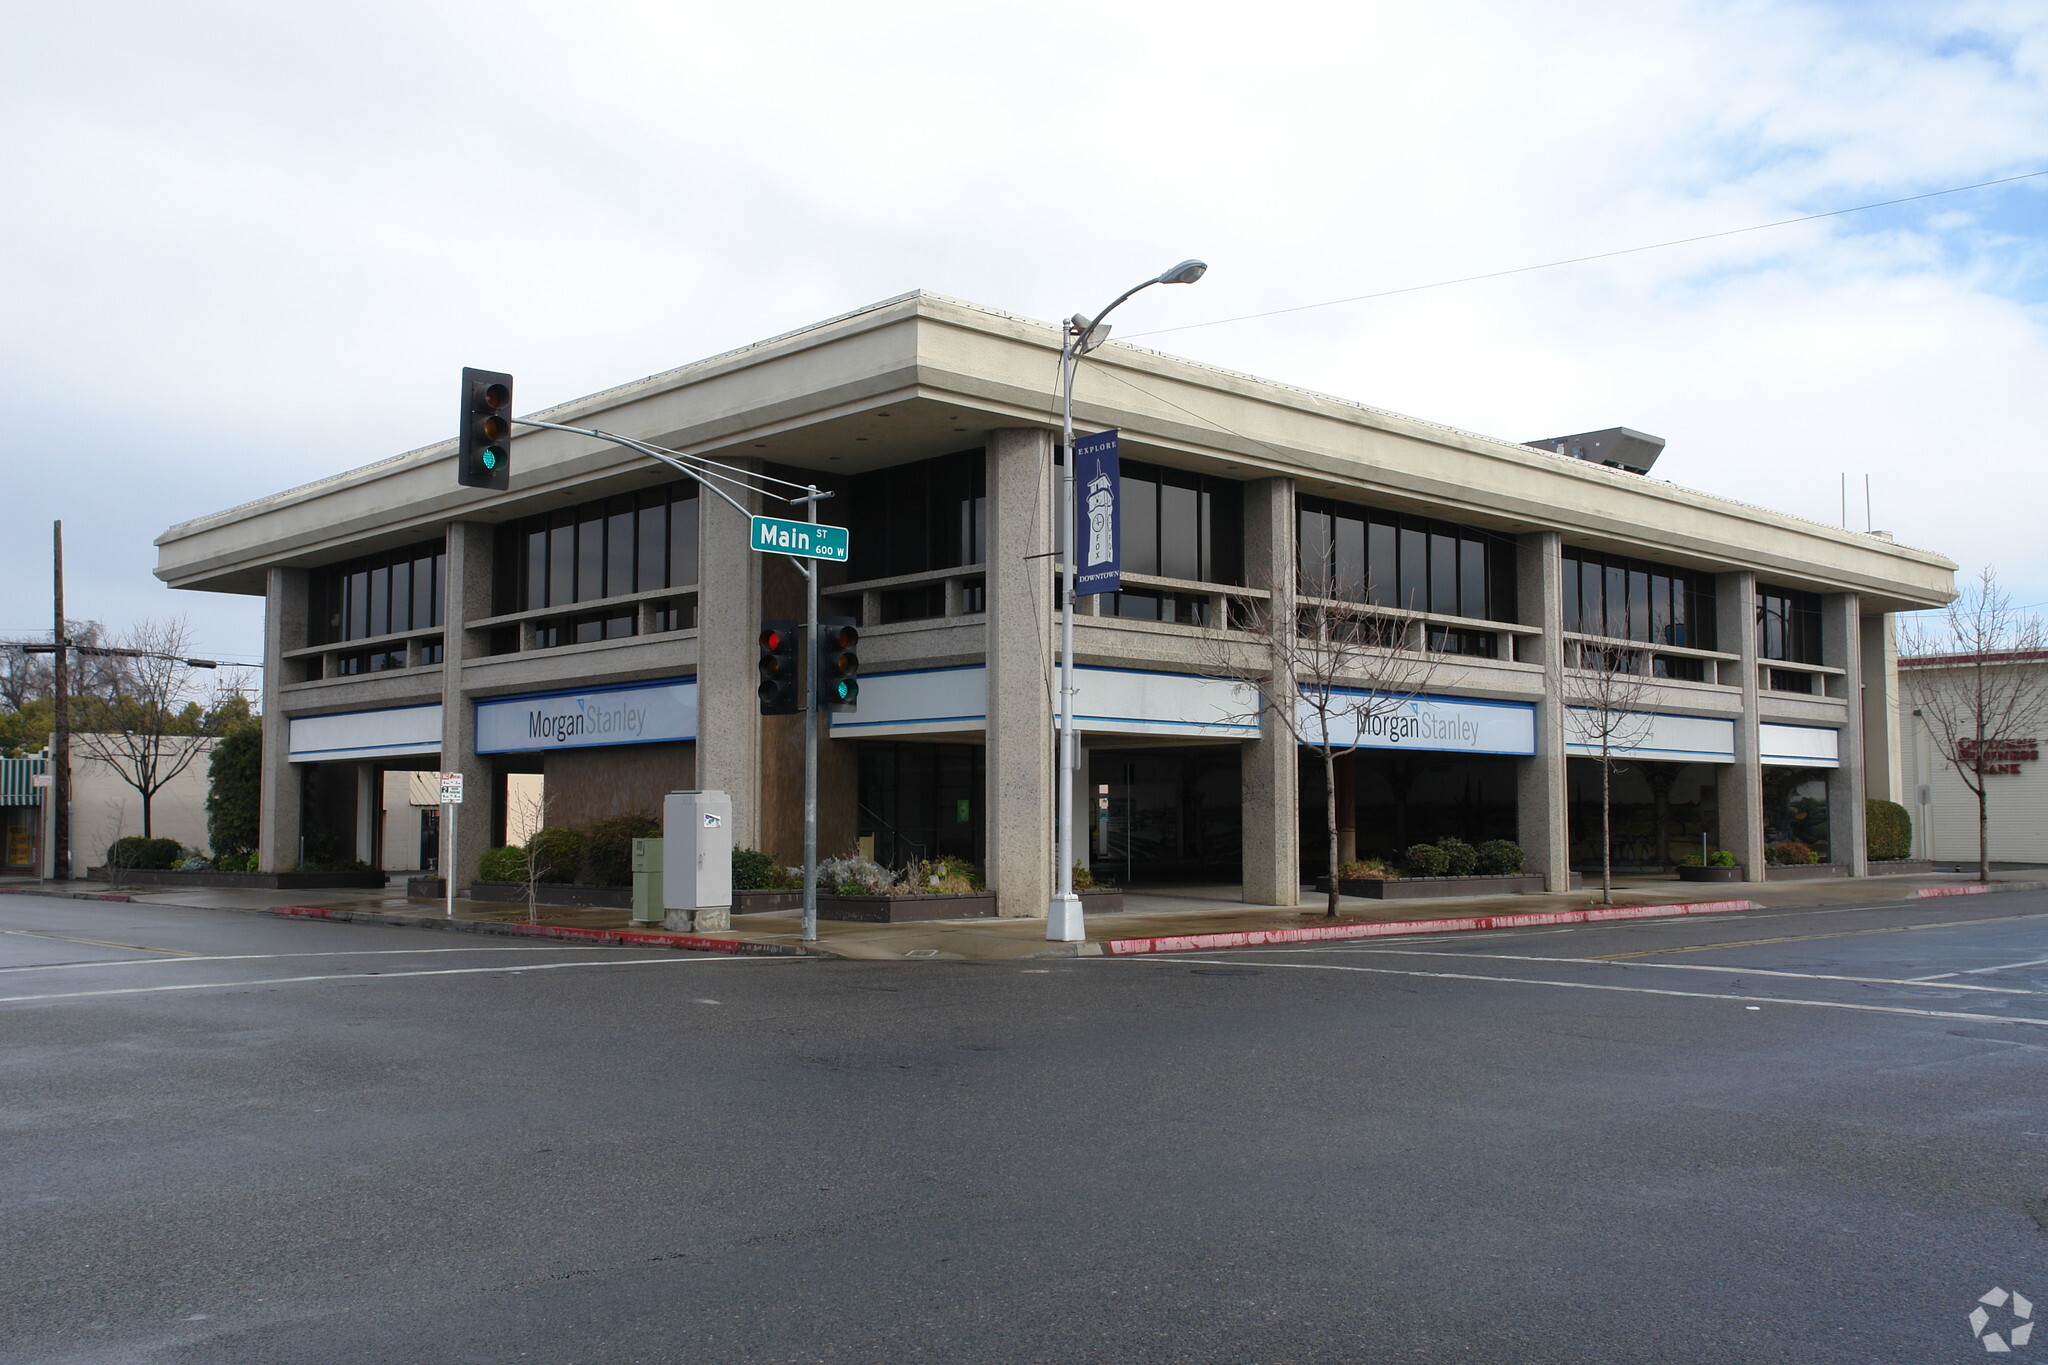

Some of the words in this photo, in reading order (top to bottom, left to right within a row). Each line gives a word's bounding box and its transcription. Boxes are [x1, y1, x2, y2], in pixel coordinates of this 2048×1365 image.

[1078, 441, 1117, 455] EXPLORE
[761, 523, 810, 550] Main
[816, 529, 828, 539] ST
[815, 545, 834, 555] 600
[837, 547, 845, 557] W
[1079, 570, 1119, 583] DOWNTOWN
